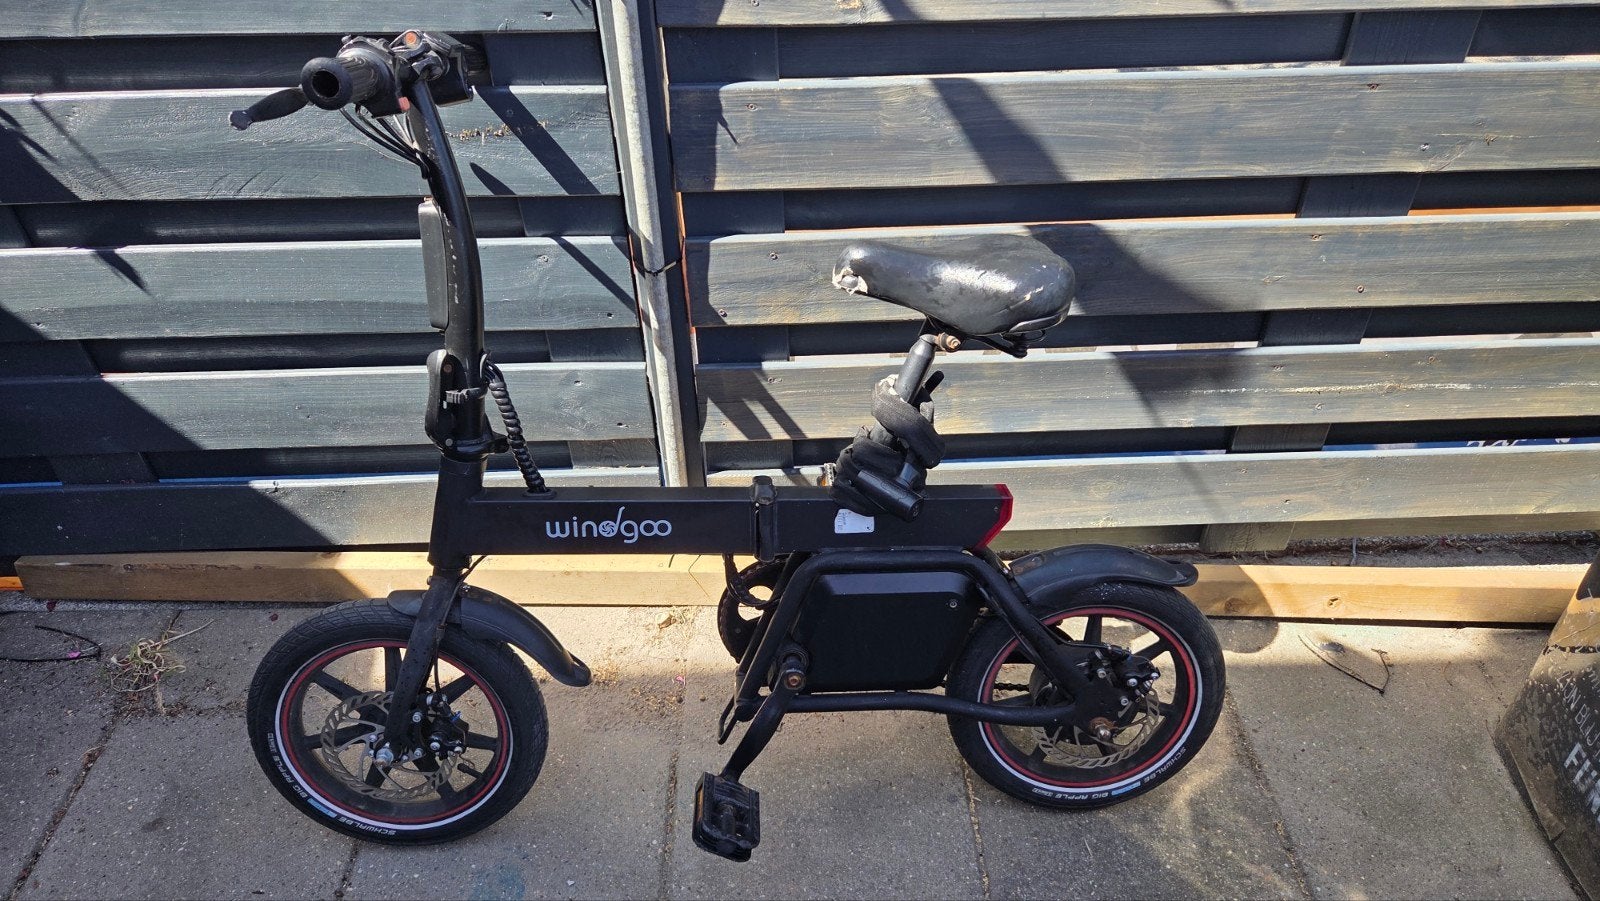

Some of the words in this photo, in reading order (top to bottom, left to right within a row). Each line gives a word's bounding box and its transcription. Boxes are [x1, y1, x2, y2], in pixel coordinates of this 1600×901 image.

[546, 506, 672, 543] windgoo
[272, 755, 295, 783] APPLE
[1143, 746, 1187, 783] SCHWALBE
[292, 784, 308, 798] BIG
[1091, 791, 1109, 799] BIG
[338, 816, 397, 836] SCHWALBE
